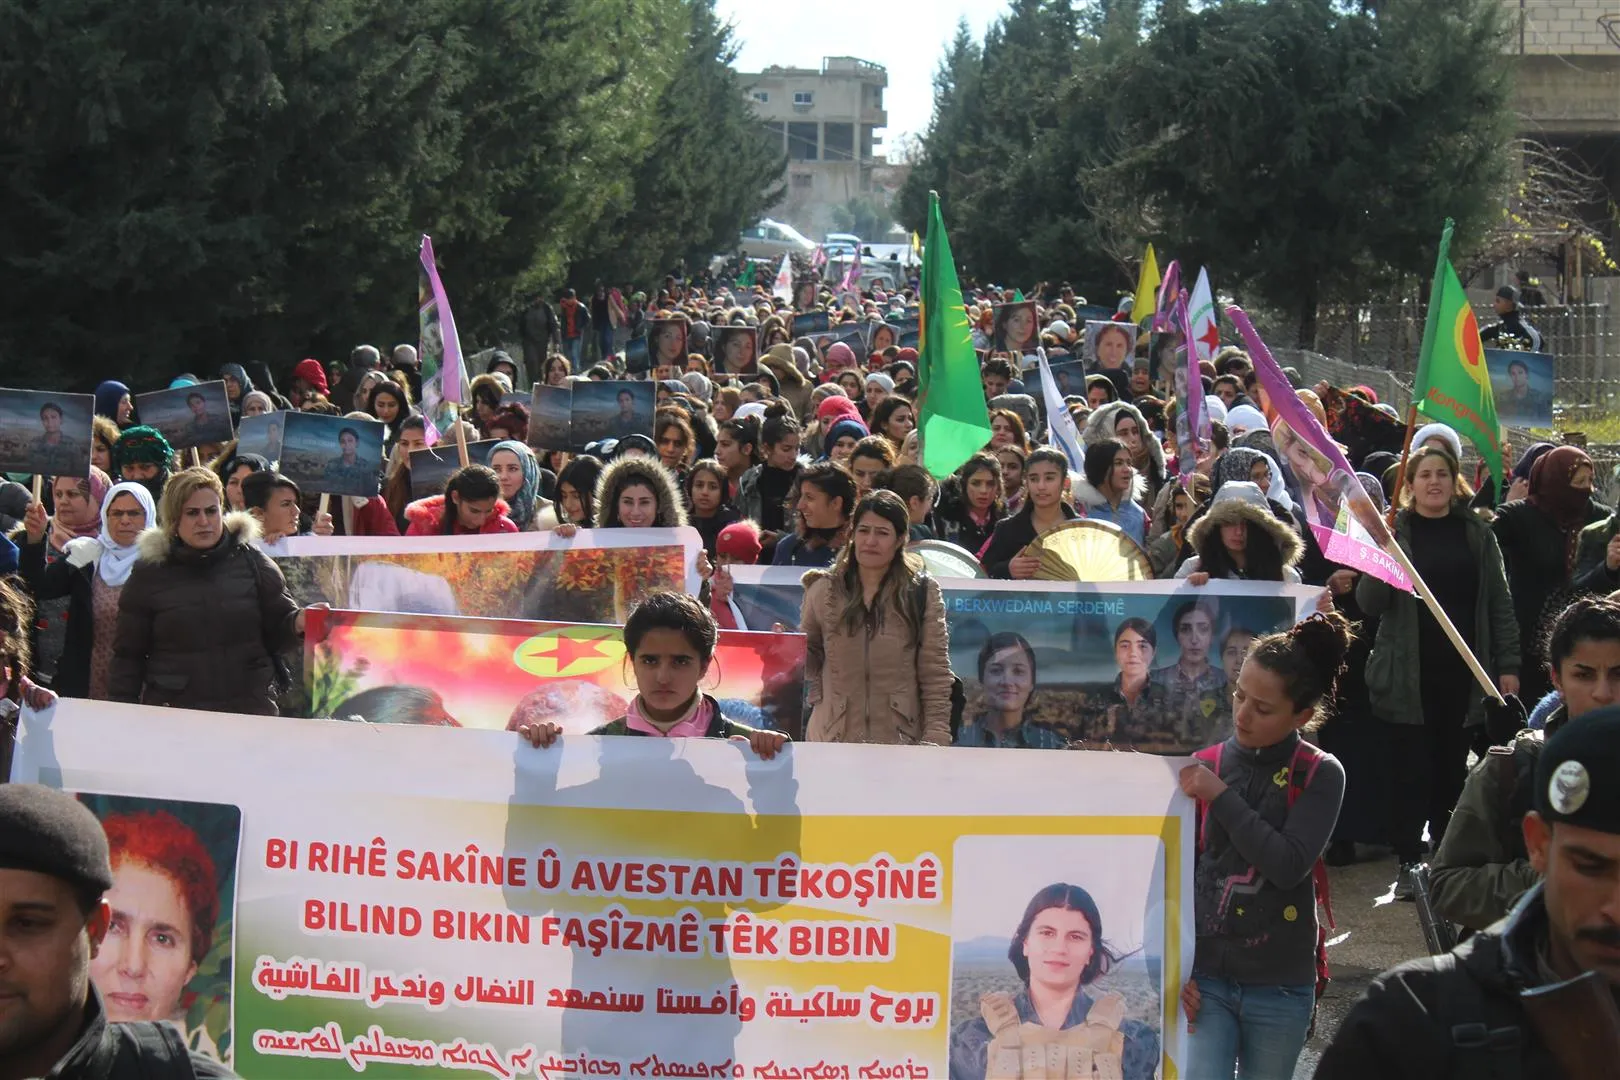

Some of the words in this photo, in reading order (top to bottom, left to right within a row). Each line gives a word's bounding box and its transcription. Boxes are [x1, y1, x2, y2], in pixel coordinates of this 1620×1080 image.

[955, 598, 1053, 614] BERXWEDANA
[1057, 599, 1125, 616] SERDEMÊ
[266, 839, 297, 869] BI
[309, 837, 386, 876] RIHÊ
[397, 845, 526, 886] SAKÎNE
[538, 849, 560, 888] Û
[572, 861, 742, 896] AVESTAN
[754, 857, 937, 907] TÊKOŞÎNÊ
[305, 900, 421, 936] BILIND
[434, 910, 529, 944] BIKIN
[541, 909, 698, 957] FAŞÎZMÊ
[709, 914, 778, 954] TÊK
[790, 926, 889, 956] BIBIN
[259, 962, 359, 993] الفاشية
[371, 974, 445, 1005] وندحر
[455, 977, 533, 1005] النضال
[546, 986, 644, 1012] سنصعد
[656, 984, 755, 1021] وأفستا
[765, 991, 861, 1023] ساكينة
[870, 991, 933, 1023] بروح
